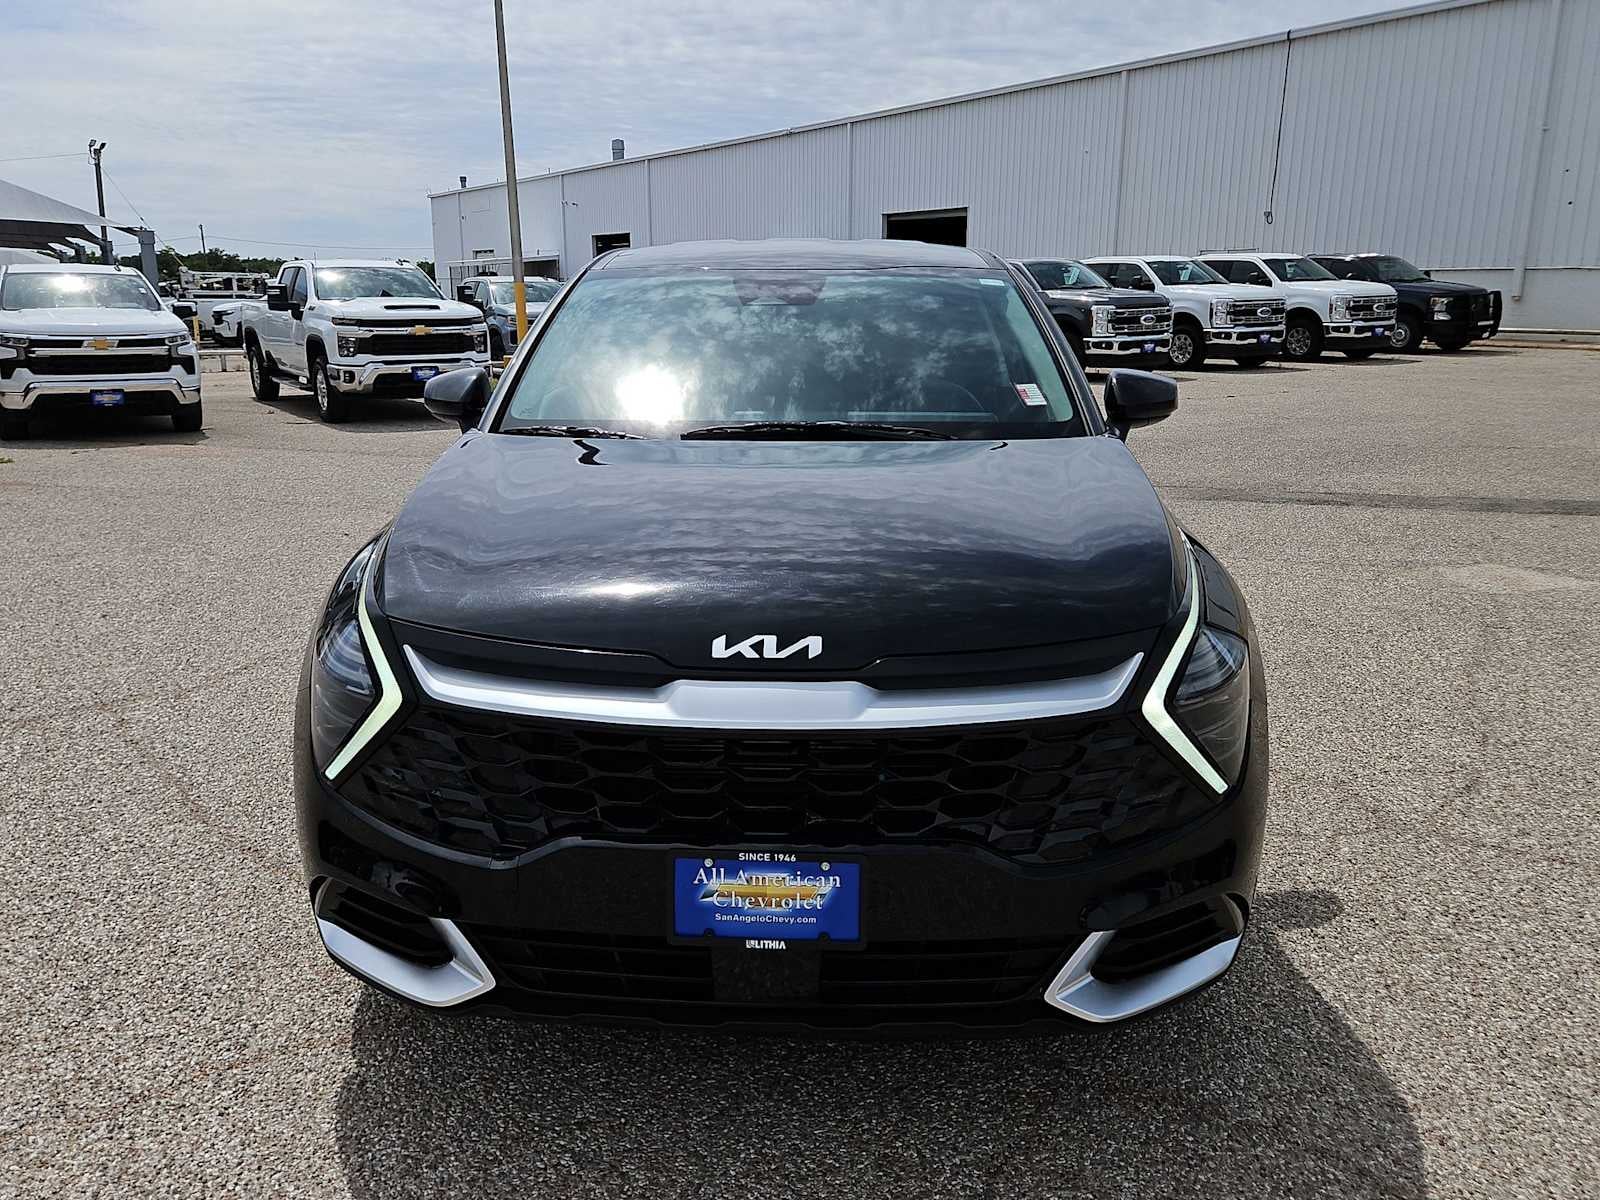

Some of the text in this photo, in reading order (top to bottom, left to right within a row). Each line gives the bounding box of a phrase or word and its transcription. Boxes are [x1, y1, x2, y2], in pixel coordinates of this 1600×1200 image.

[711, 634, 823, 659] KIA
[738, 852, 797, 862] SINCE 1946
[693, 867, 841, 888] All American
[712, 890, 823, 910] Chevrolet
[715, 913, 817, 924] SanAngeloChevy.com
[754, 940, 787, 950] LITHIA
